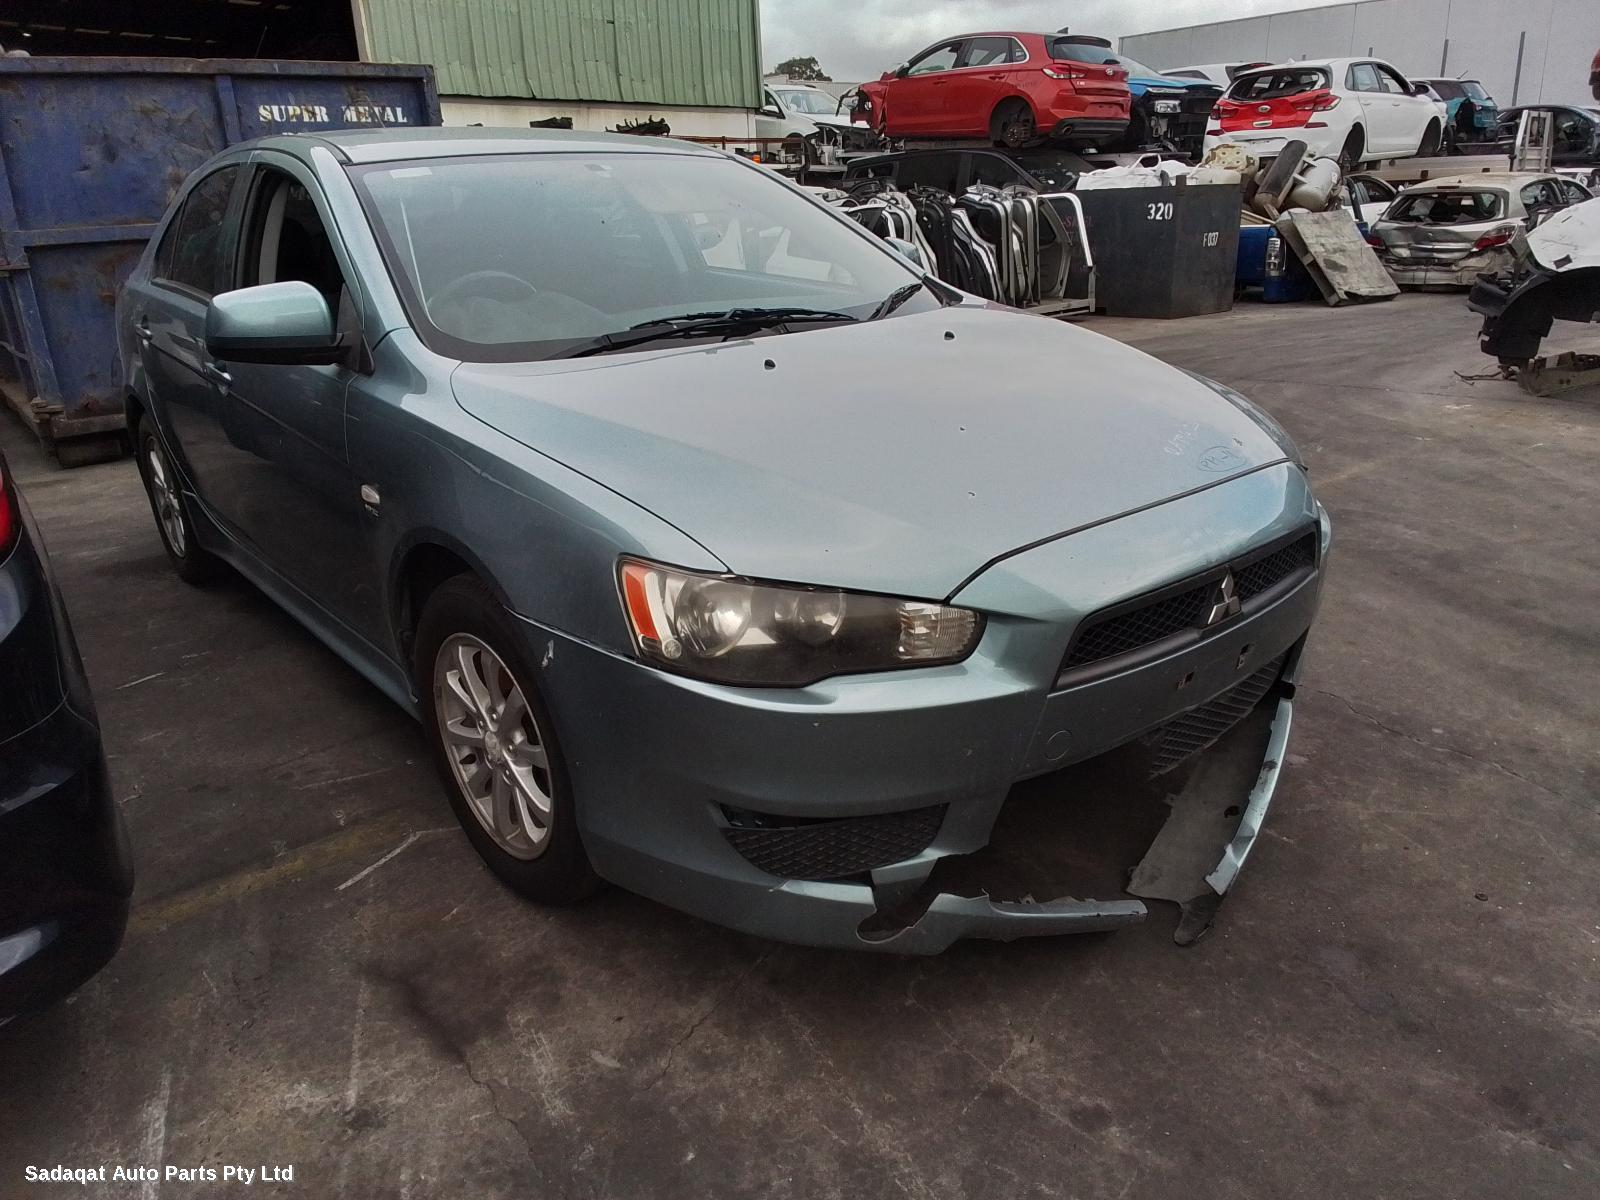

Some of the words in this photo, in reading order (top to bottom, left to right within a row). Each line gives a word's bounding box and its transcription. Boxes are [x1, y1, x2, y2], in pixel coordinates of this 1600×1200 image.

[258, 105, 329, 123] SUPER
[342, 105, 408, 123] METAL
[1147, 202, 1174, 220] 320
